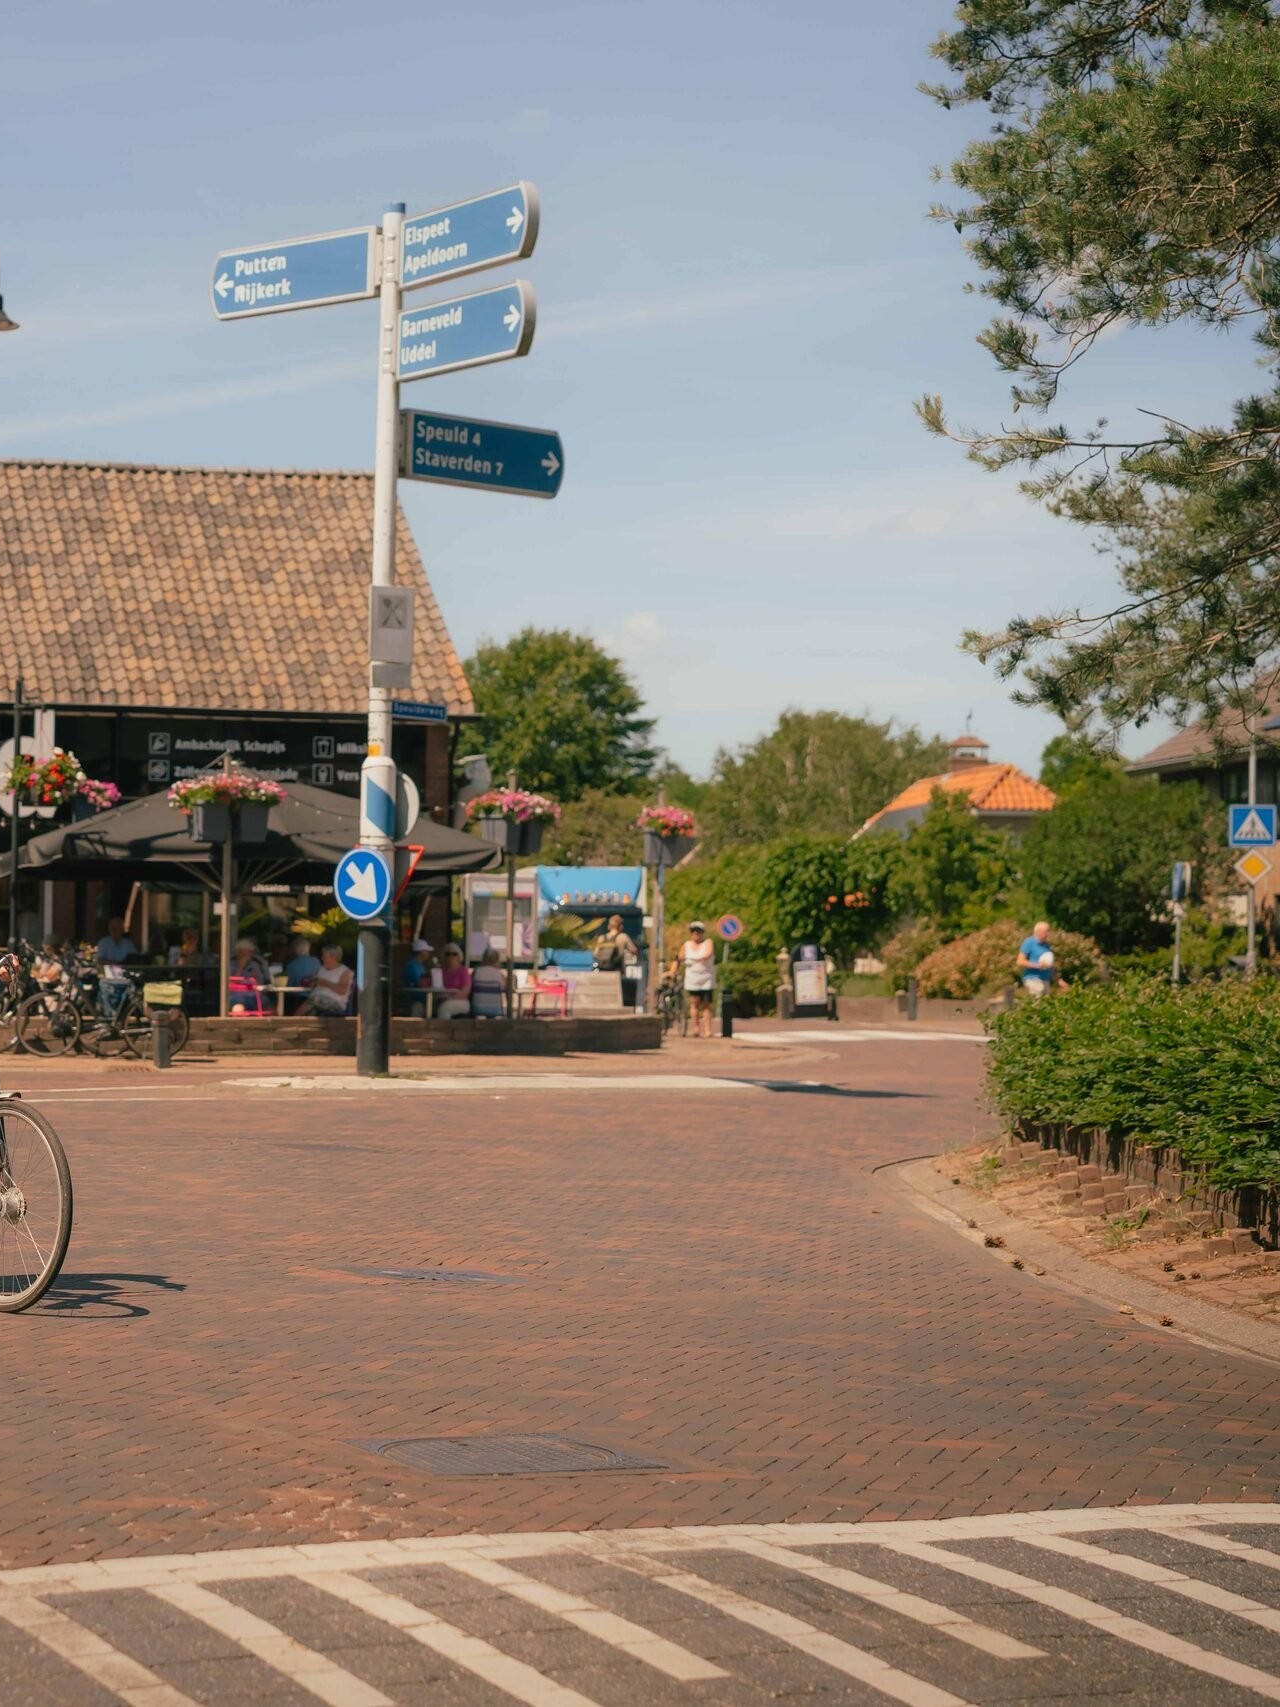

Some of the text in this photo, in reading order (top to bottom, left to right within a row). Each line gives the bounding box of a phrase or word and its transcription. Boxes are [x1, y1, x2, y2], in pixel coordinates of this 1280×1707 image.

[405, 217, 450, 246] Elspeet
[235, 256, 287, 277] Putten
[404, 242, 468, 275] Apeldoorn
[234, 278, 291, 305] Nijkerk
[402, 306, 462, 338] Barneveld
[401, 340, 437, 365] Uddel
[416, 421, 481, 446] Speuld 4
[415, 447, 504, 476] Staverden 7
